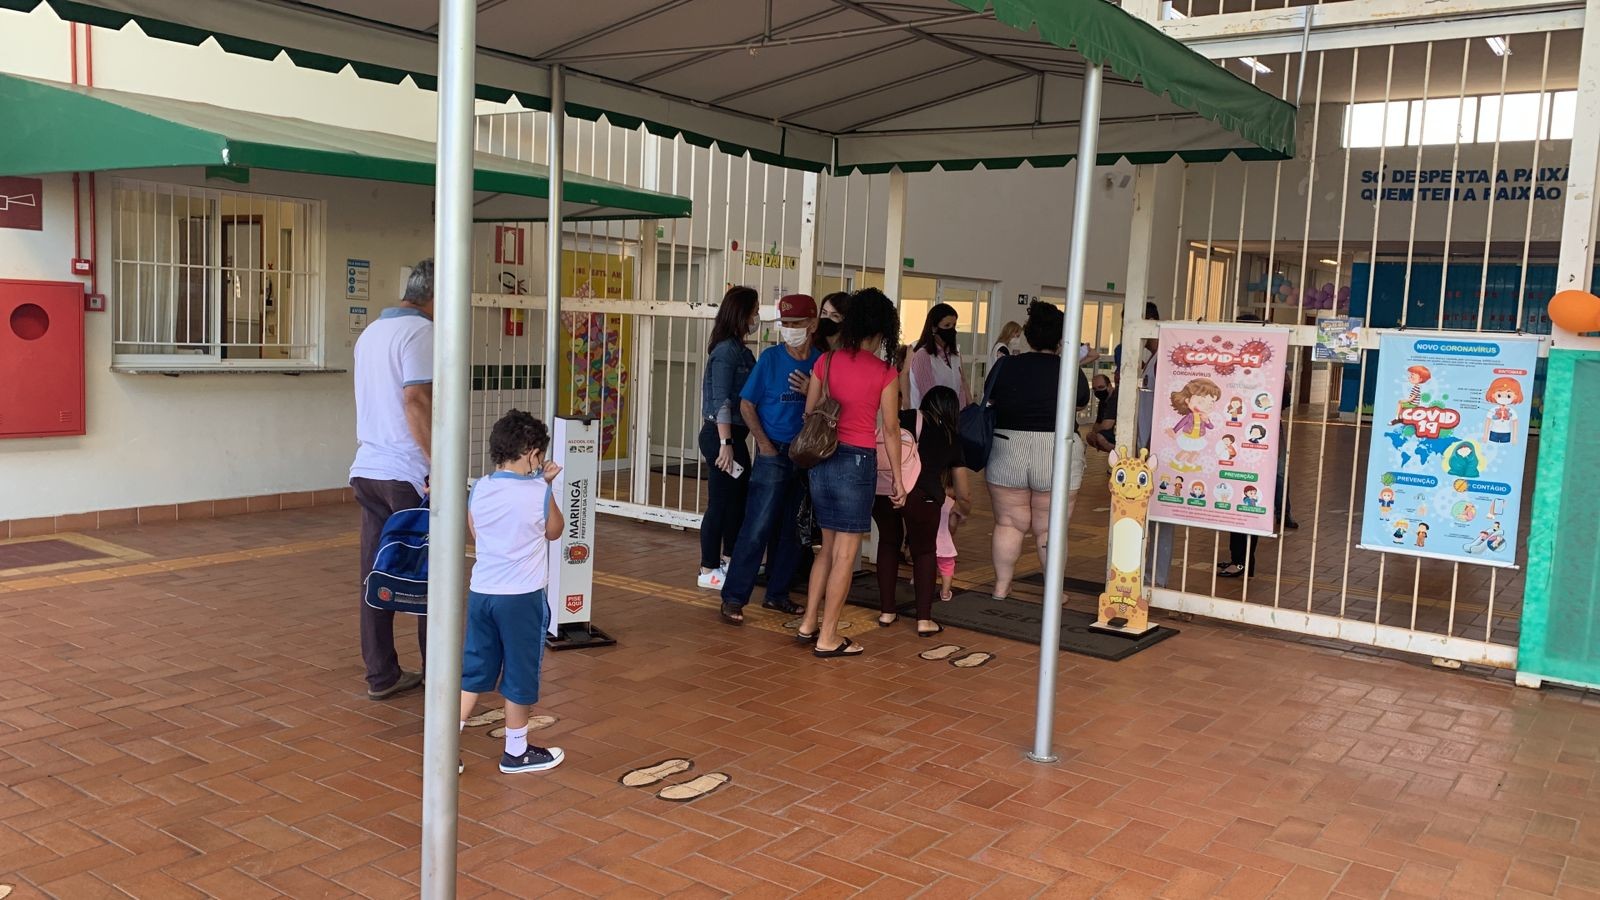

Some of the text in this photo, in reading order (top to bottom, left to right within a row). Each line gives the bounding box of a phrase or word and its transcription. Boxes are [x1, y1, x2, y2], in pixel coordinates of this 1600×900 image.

[1360, 164, 1387, 183] SÓ
[1391, 169, 1490, 184] DESPERTA
[1495, 169, 1509, 183] A
[1360, 187, 1414, 202] QUEM
[1462, 187, 1477, 201] A
[1483, 184, 1562, 201] PAIXÃO
[1416, 343, 1497, 354] NOVO CORONAVÍRUS
[1186, 352, 1260, 364] COVID-19
[1402, 408, 1457, 424] COVID
[1418, 420, 1438, 434] 19
[1224, 472, 1255, 480] PREVENÇÃO
[1397, 475, 1436, 485] PREVENÇÃO
[1471, 482, 1507, 492] CONTÁGIO
[568, 480, 581, 539] MARINGÁ
